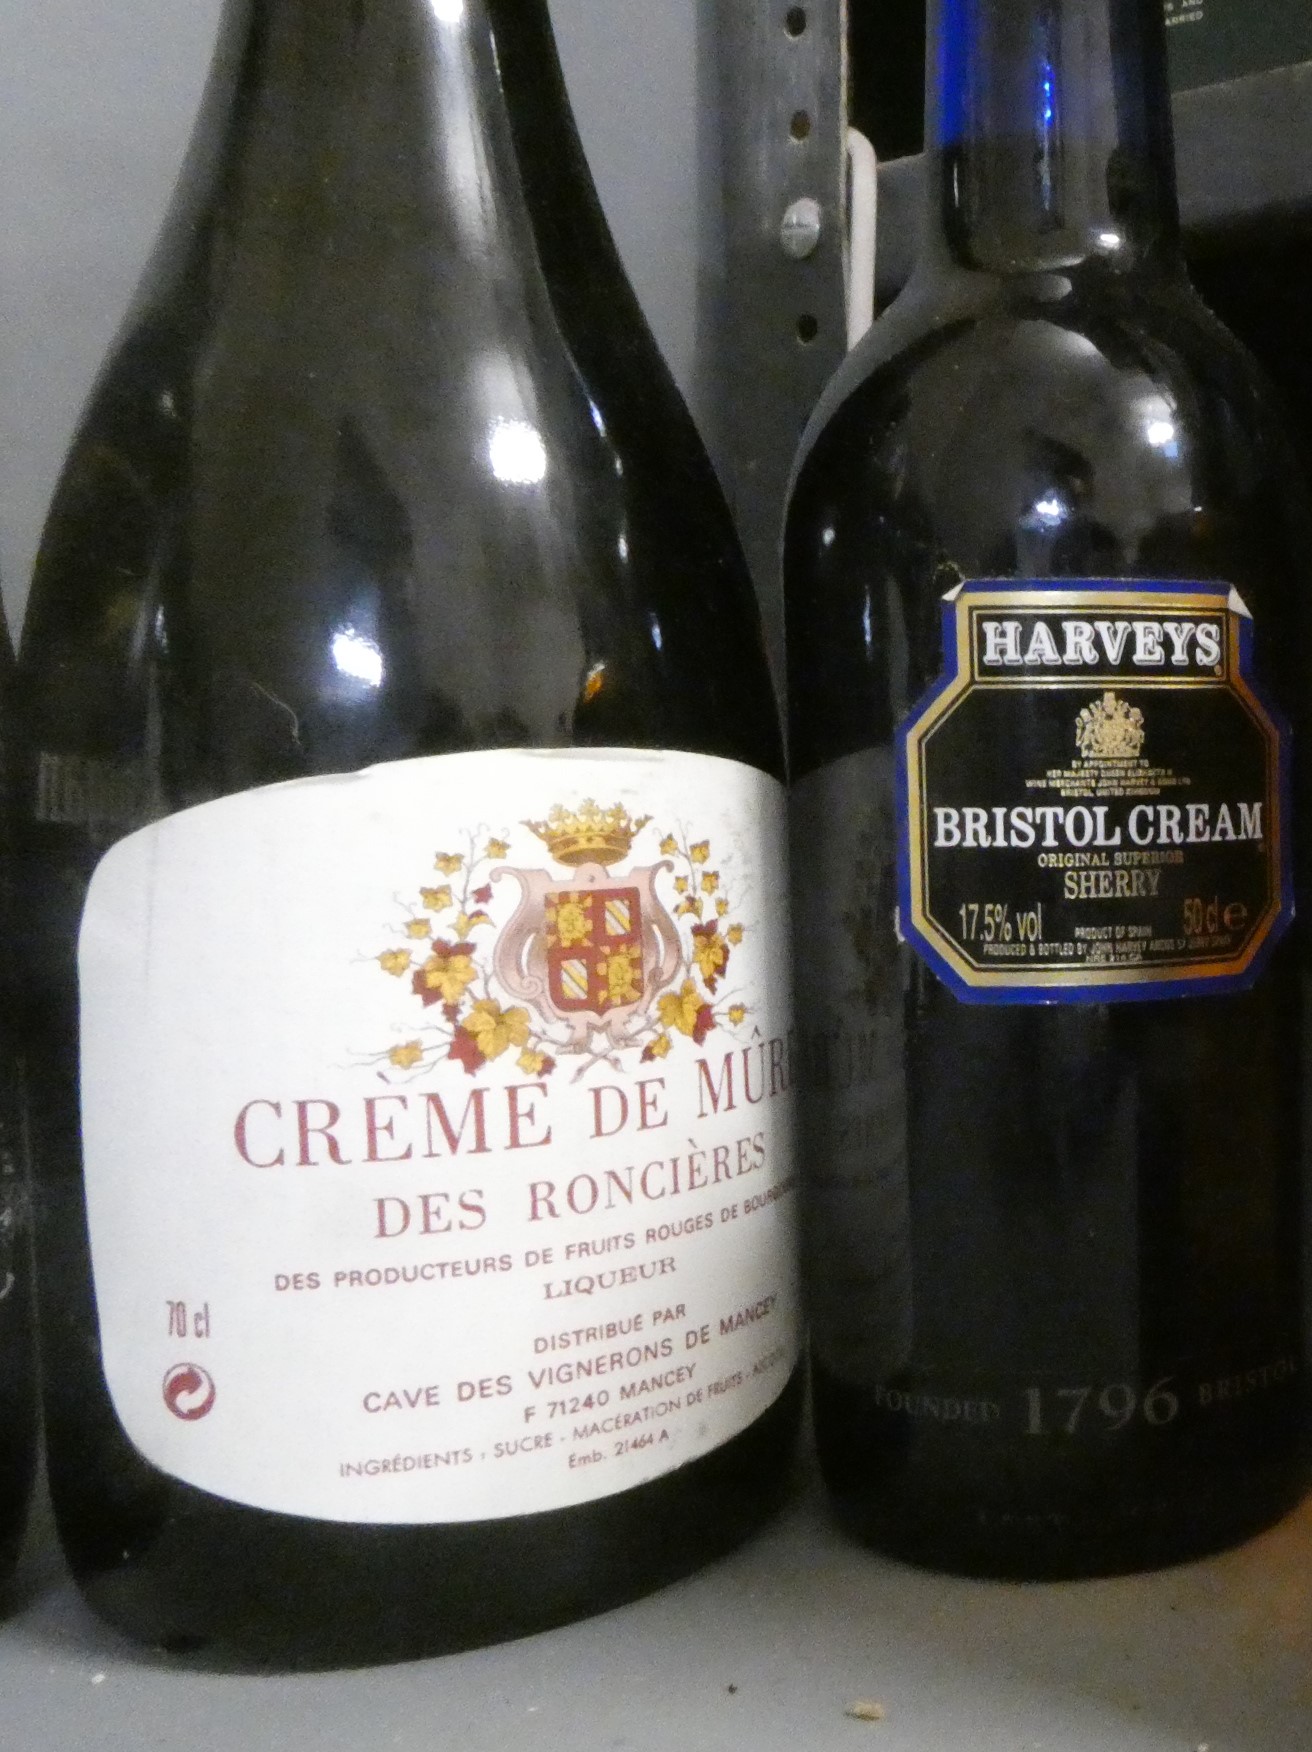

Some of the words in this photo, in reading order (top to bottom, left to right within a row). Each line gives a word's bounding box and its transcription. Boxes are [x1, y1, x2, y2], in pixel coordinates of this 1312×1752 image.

[982, 619, 1221, 667] HARVEYS
[934, 806, 1120, 848] BRISTOL
[1128, 802, 1262, 844] CREAM
[1037, 853, 1110, 868] ORIGINAL
[1113, 851, 1184, 866] SUPERIOR
[1064, 869, 1162, 900] SHERRY
[959, 903, 1012, 942] 17.5%
[1016, 902, 1042, 941] vol
[234, 1071, 552, 1168] CRÈME
[587, 1077, 668, 1139] DE
[695, 1025, 796, 1118] MÛR
[373, 1189, 487, 1239] DES
[528, 1132, 766, 1222] RONCIÈRES
[274, 1272, 321, 1291] DES
[334, 1254, 512, 1288] PRODUCTEURS
[525, 1248, 553, 1267] DE
[565, 1233, 635, 1260] FRUITS
[646, 1212, 713, 1244] ROUGES
[721, 1204, 738, 1223] DE
[544, 1257, 677, 1300] LIQUEUR
[166, 1300, 187, 1338] 70
[194, 1302, 210, 1338] cl
[653, 1304, 686, 1326] PAR
[363, 1385, 440, 1413] CAVE
[457, 1375, 513, 1402] DES
[528, 1338, 673, 1389] VIGNERONS
[685, 1325, 710, 1350] DE
[720, 1293, 779, 1336] MANCEY
[524, 1406, 536, 1424] F
[547, 1389, 610, 1419] 71240
[619, 1362, 697, 1400] MANCEY
[1023, 1376, 1180, 1435] 1796
[494, 1432, 553, 1459] SUCRE
[686, 1388, 703, 1408] DE
[659, 1429, 669, 1442] A
